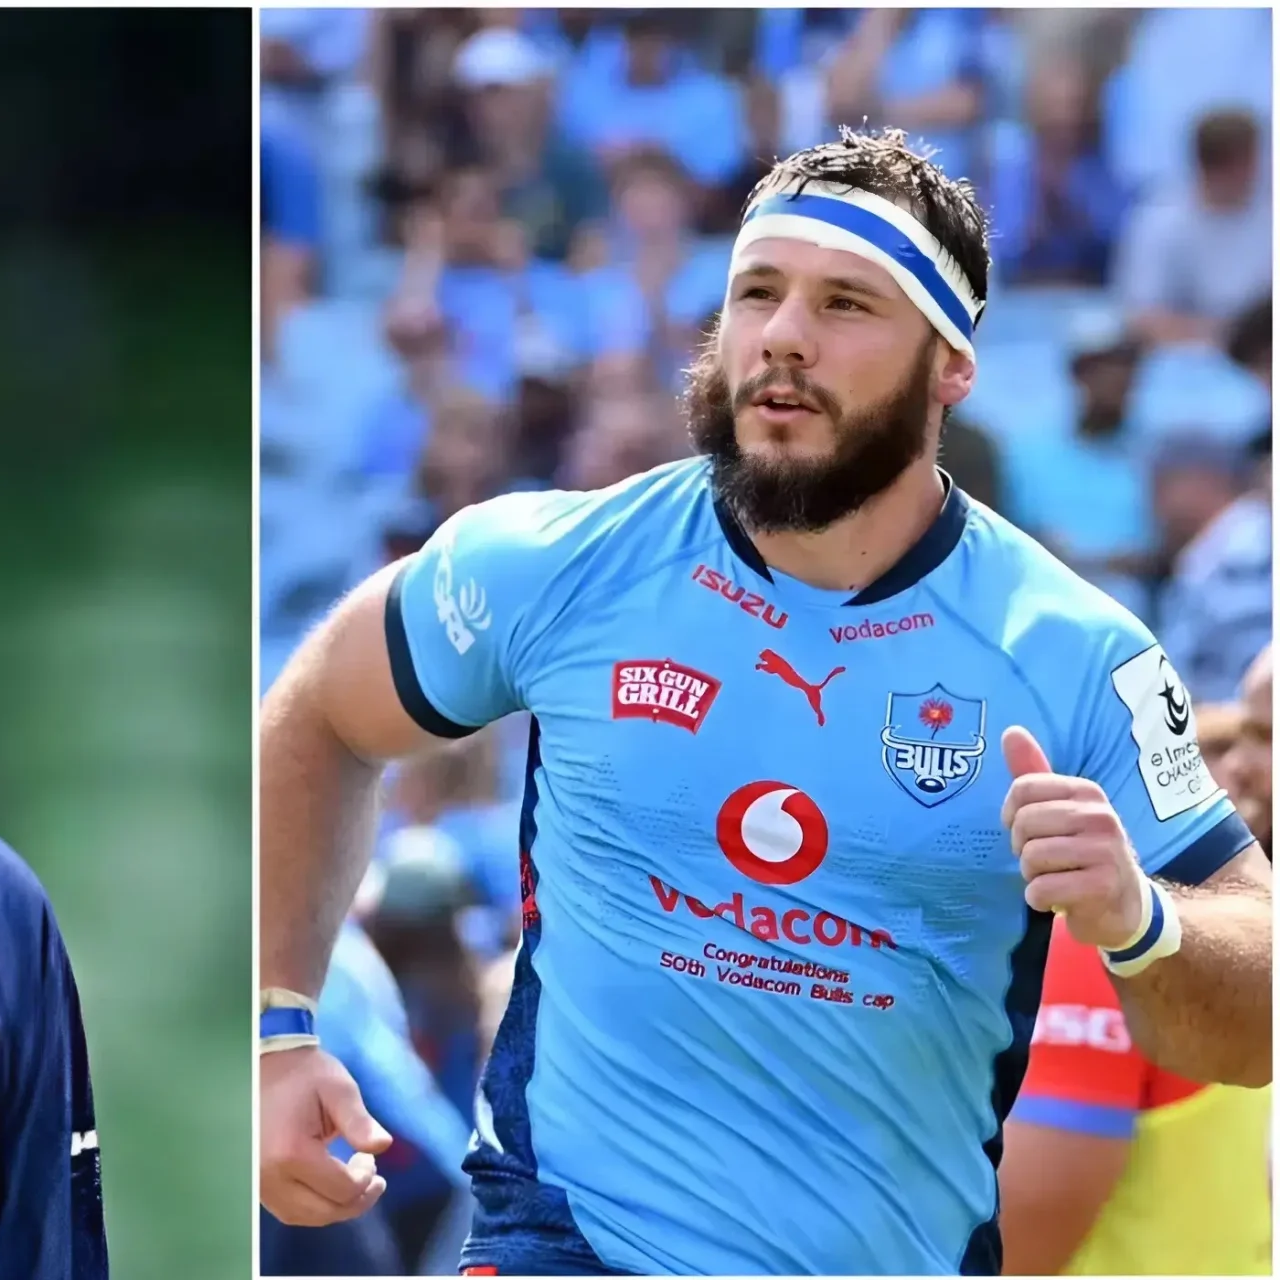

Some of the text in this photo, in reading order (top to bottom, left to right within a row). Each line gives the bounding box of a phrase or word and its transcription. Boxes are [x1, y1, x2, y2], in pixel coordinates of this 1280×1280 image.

[691, 564, 789, 629] ISUZU
[829, 612, 934, 644] vodacom
[619, 666, 709, 698] SIX GUN
[618, 683, 700, 719] GRILL
[896, 745, 970, 778] BULLS
[703, 942, 851, 985] Congratulations
[717, 966, 801, 996] Vodacom
[810, 983, 854, 1004] Bulls
[862, 992, 895, 1010] cap
